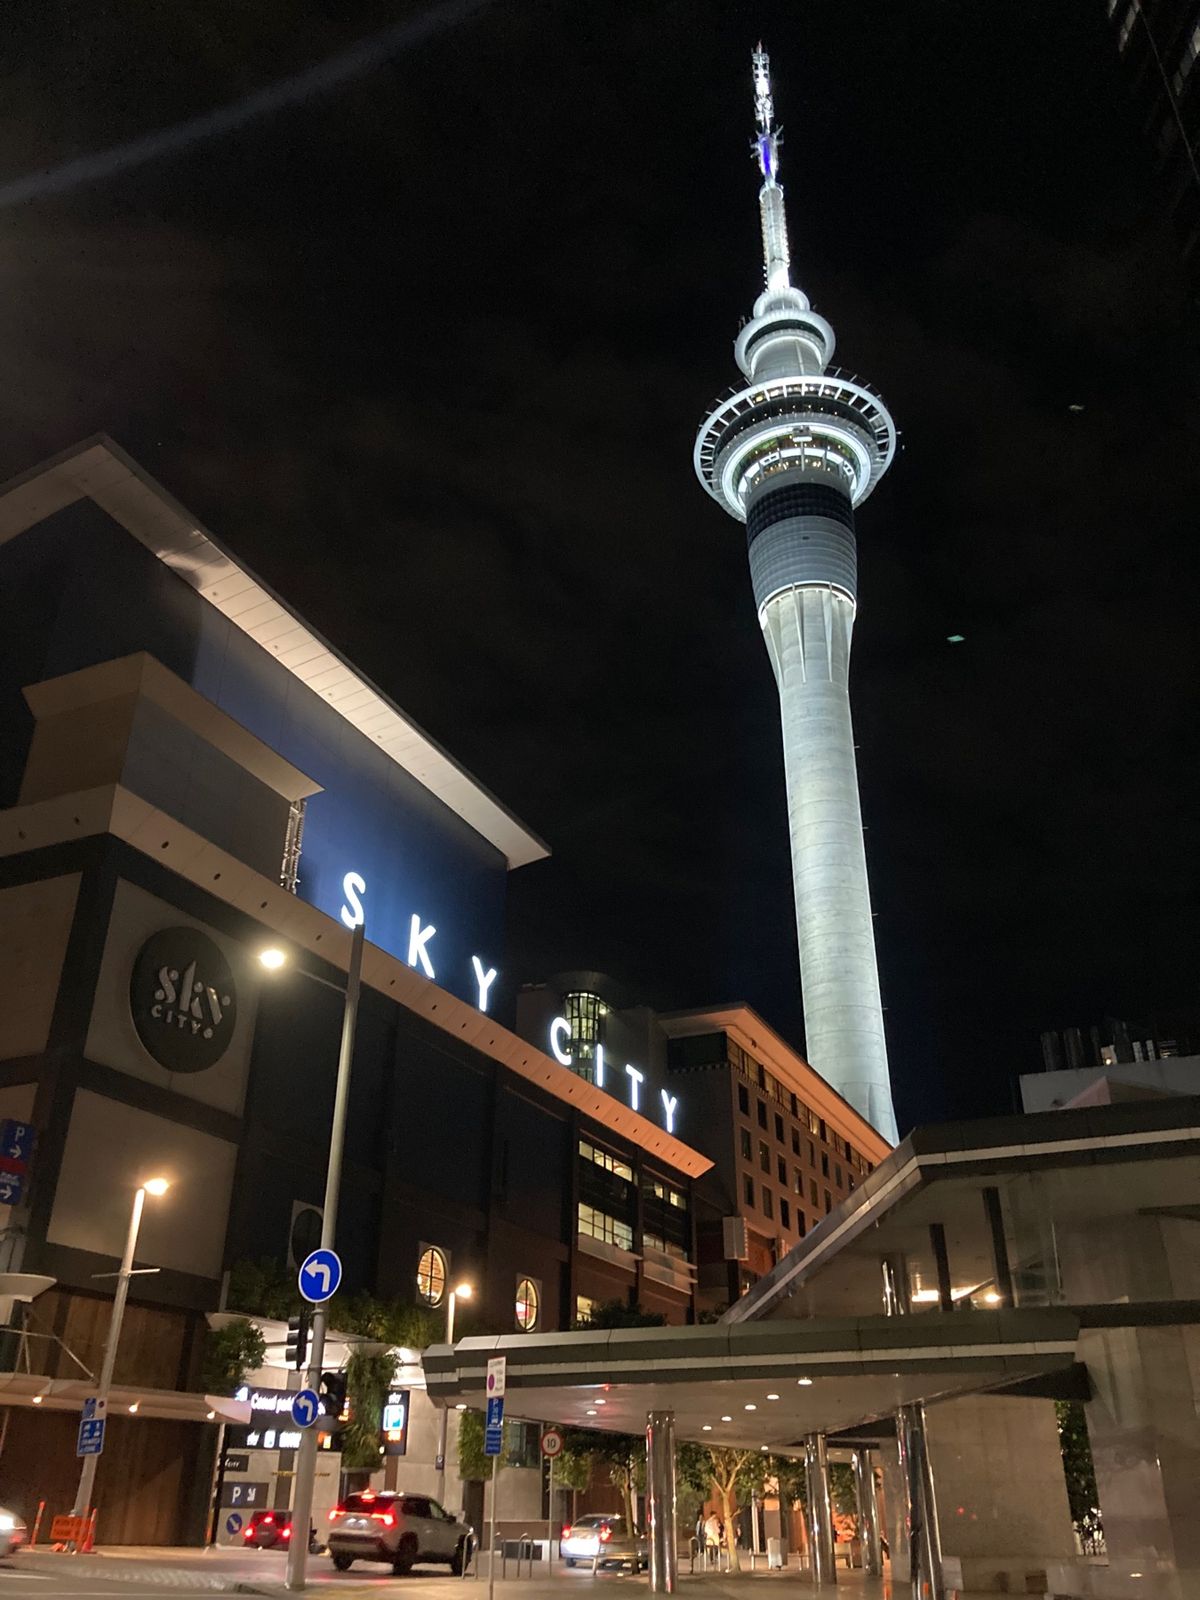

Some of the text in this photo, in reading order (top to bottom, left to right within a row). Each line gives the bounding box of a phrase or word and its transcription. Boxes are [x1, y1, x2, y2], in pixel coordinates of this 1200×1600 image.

[341, 872, 497, 1012] SKY
[151, 1004, 201, 1035] CITY
[550, 1016, 677, 1133] CITY
[15, 1127, 25, 1142] P
[546, 1438, 556, 1449] 10
[231, 1486, 242, 1504] P
